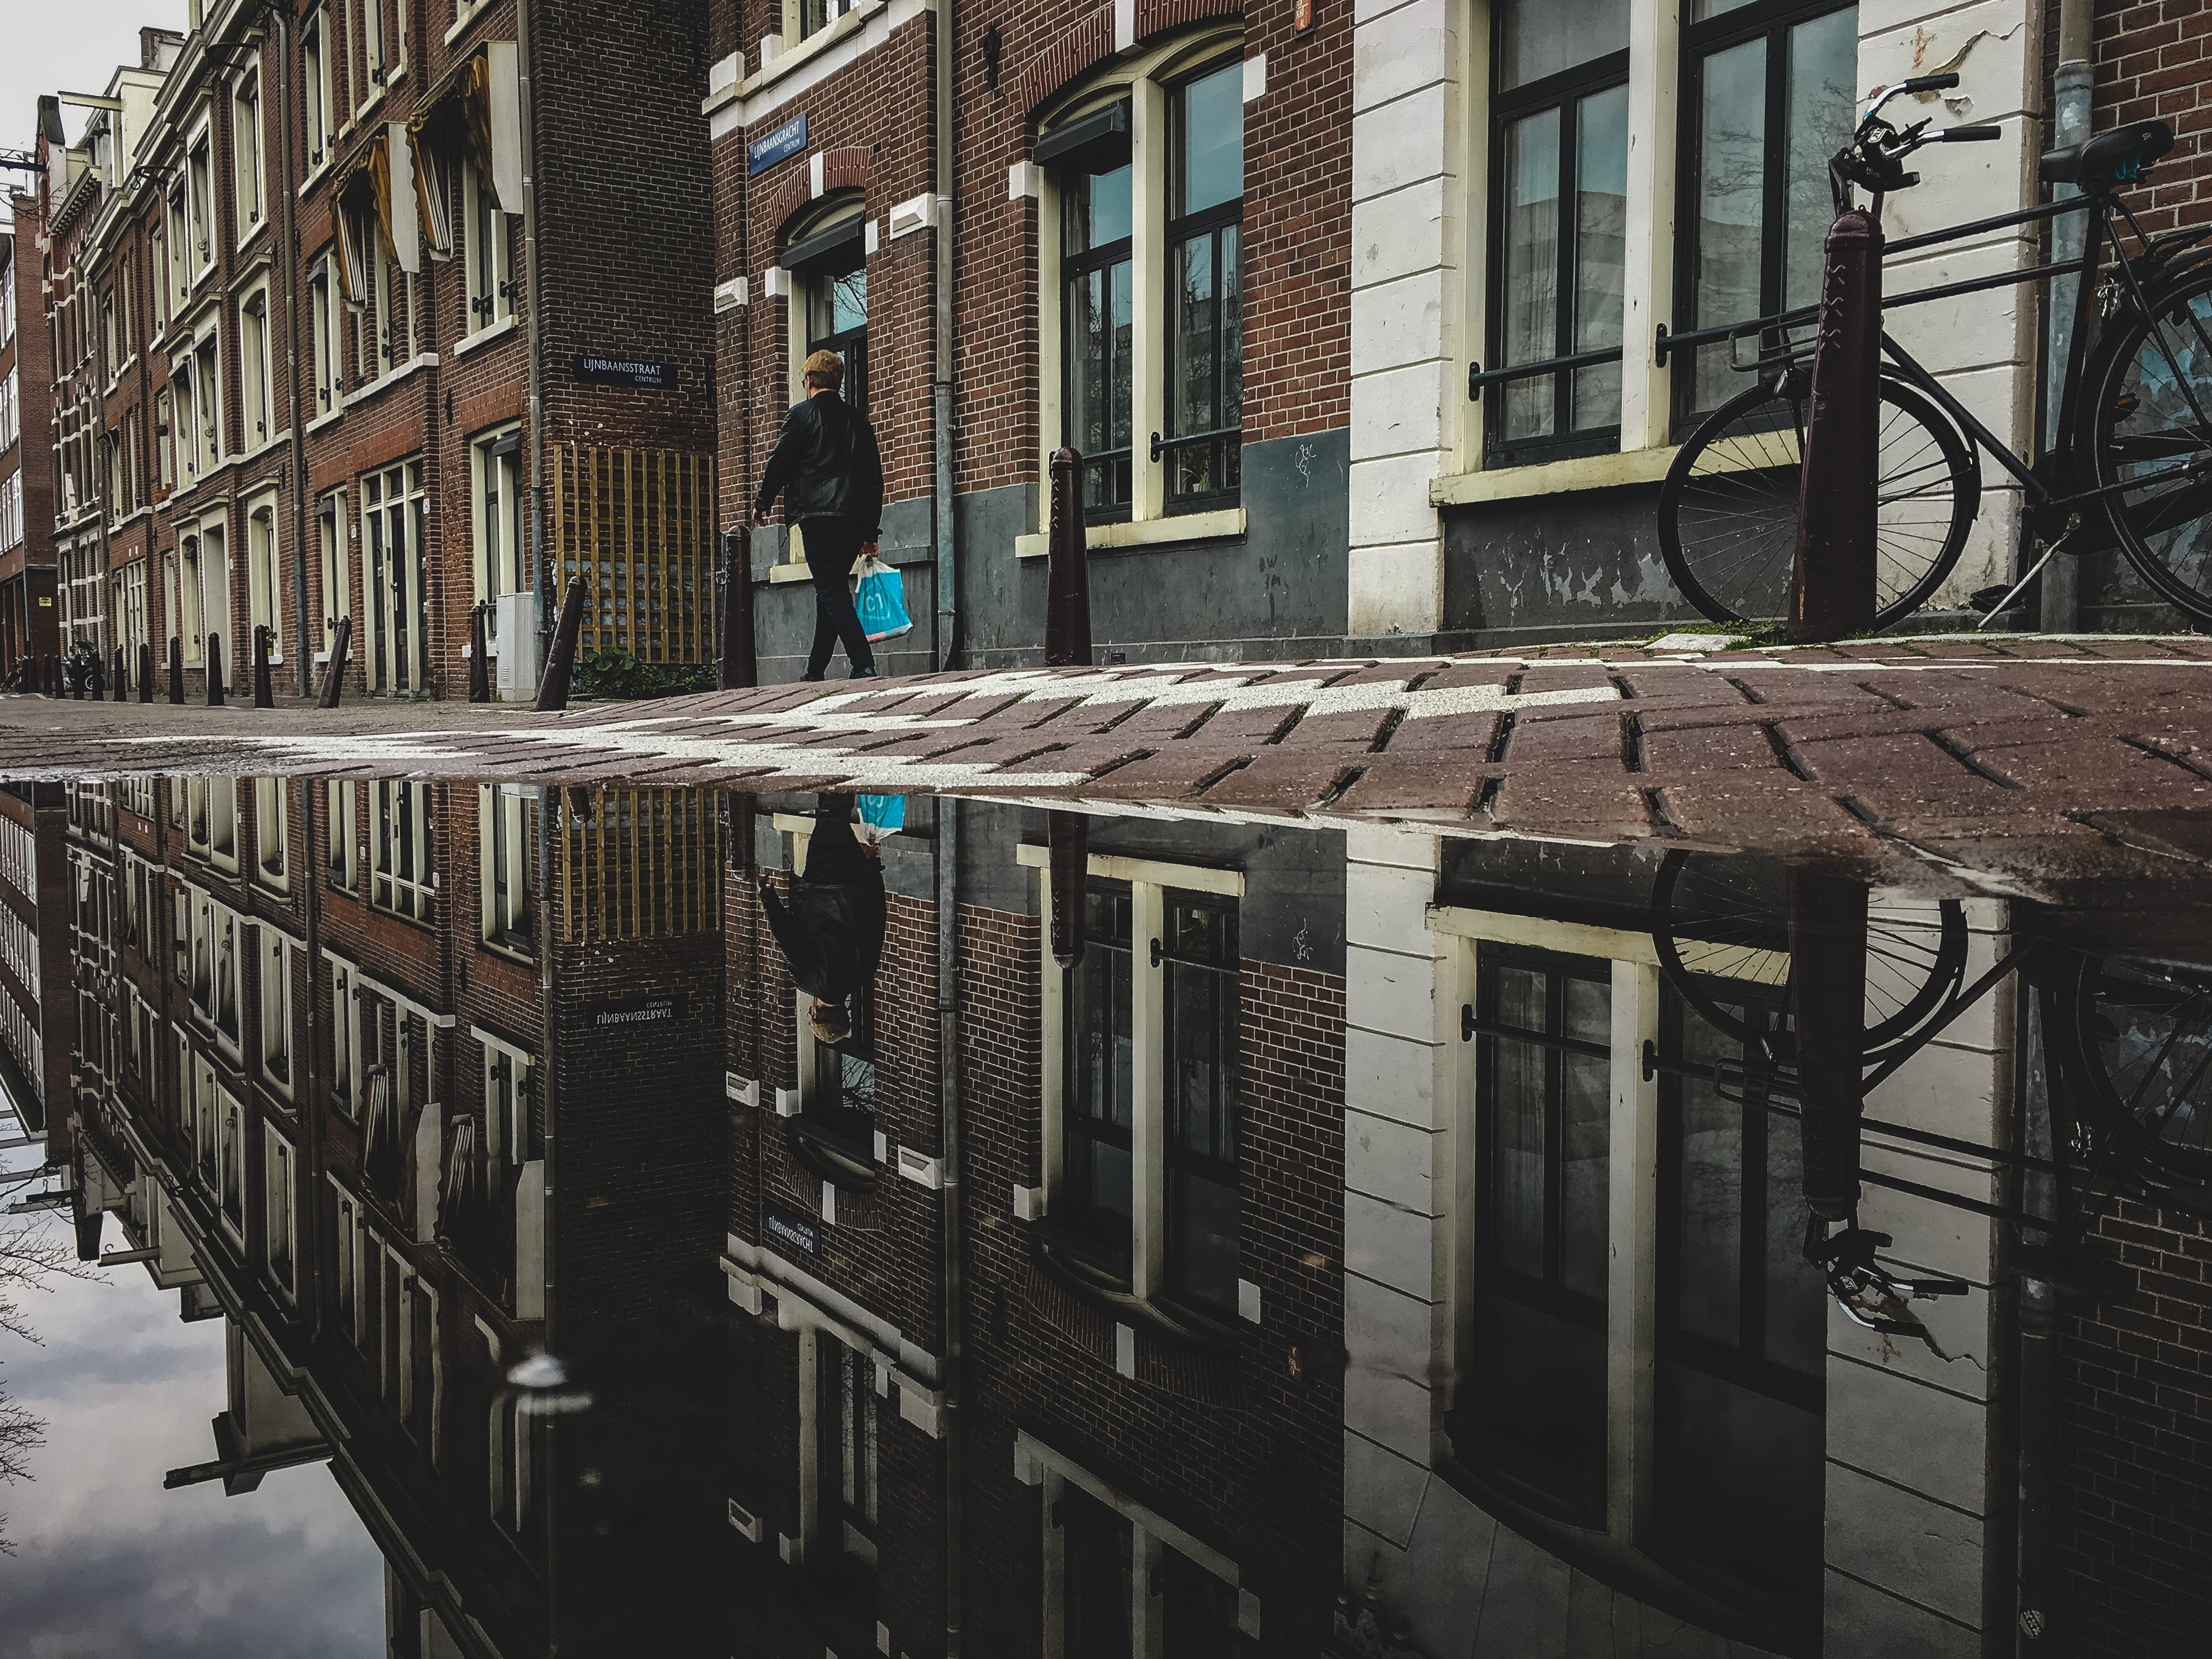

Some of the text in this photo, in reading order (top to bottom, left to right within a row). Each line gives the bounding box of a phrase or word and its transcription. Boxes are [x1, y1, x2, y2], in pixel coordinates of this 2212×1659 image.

[754, 120, 800, 161] LIJNBAANSGRACHT
[783, 138, 800, 153] CENTRUM
[584, 358, 661, 376] LIJNBAANSSTRAAT
[635, 375, 662, 384] CENTRUM
